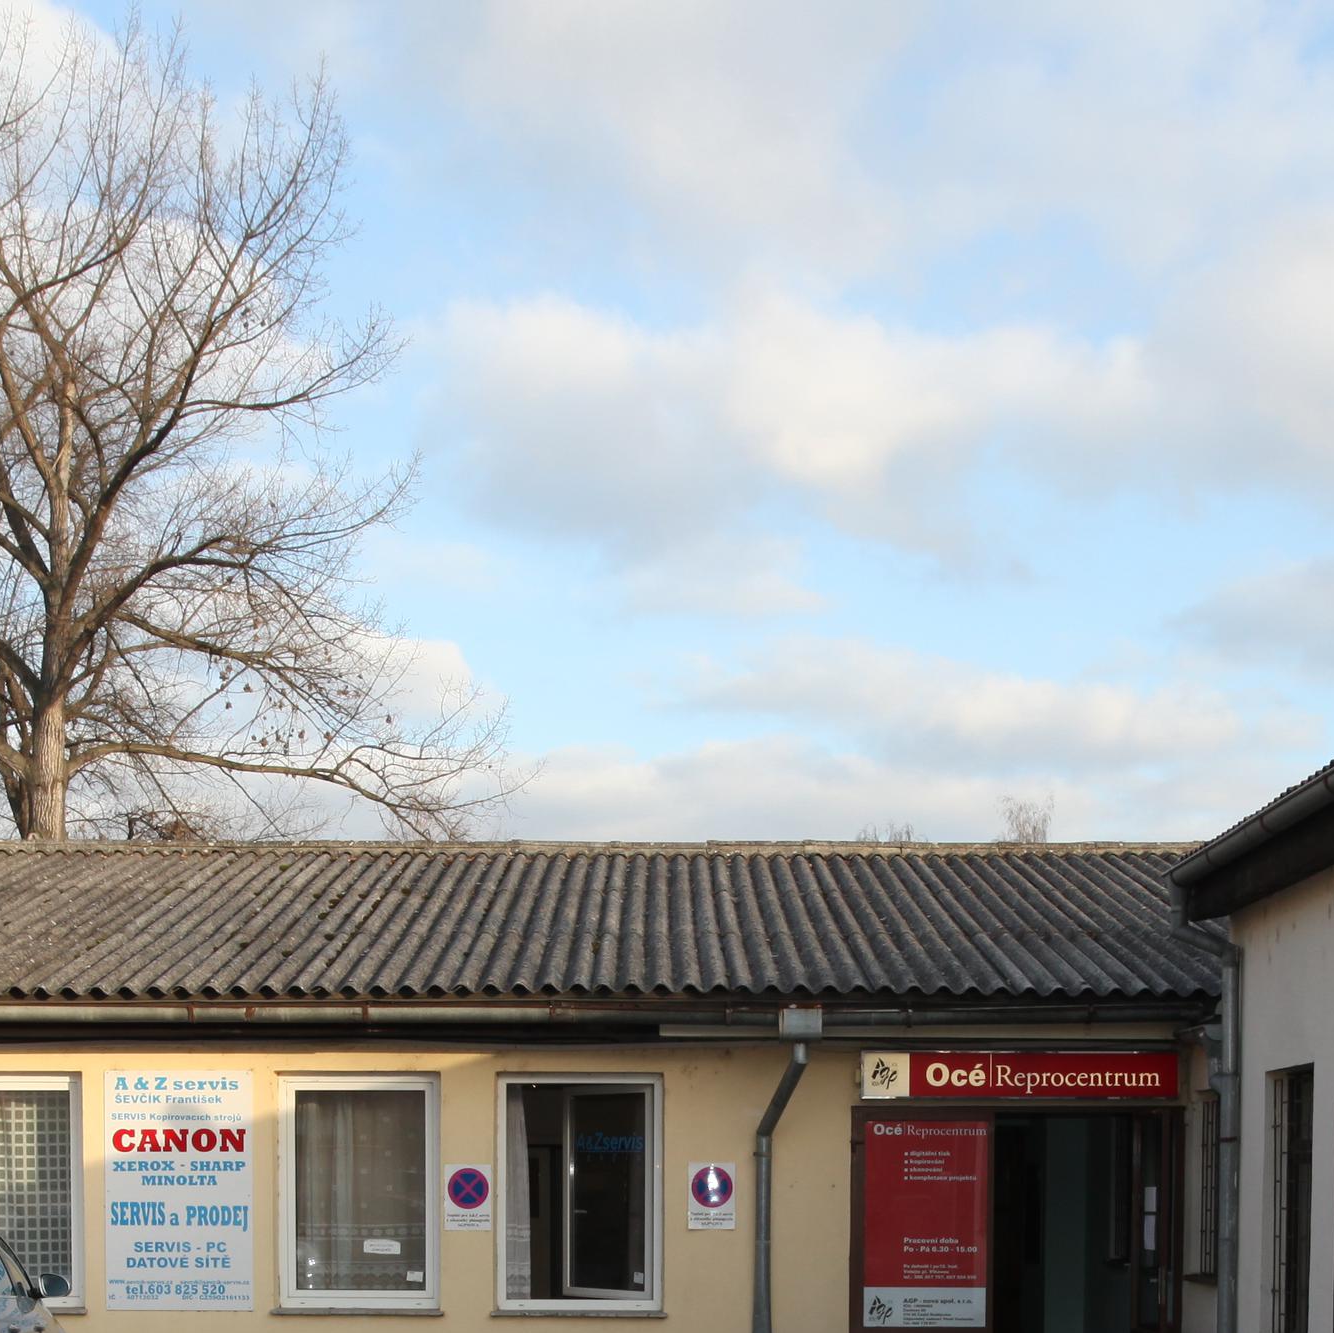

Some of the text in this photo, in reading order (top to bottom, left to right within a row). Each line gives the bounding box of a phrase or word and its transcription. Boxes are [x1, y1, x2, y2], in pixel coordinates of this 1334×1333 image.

[114, 1076, 239, 1091] A & Z servis
[925, 1062, 1161, 1094] Océ Reprocentrum
[114, 1092, 223, 1104] ŠEVČÍK František
[111, 1112, 147, 1121] SERVIS
[873, 1123, 987, 1140] Océ Reprocentrum
[112, 1128, 246, 1153] CANON
[112, 1160, 175, 1172] XEROX
[190, 1160, 246, 1172] SHARP
[141, 1175, 218, 1186] MINOLTA
[110, 1201, 249, 1232] SERVIS a PRODEJ
[903, 1236, 959, 1244] Pracovní doba
[133, 1241, 192, 1253] SERVIS
[206, 1241, 227, 1253] PC
[903, 1245, 914, 1253] Po
[126, 1254, 231, 1269] DATOVÉ SÍTĚ
[175, 1284, 198, 1295] 825
[202, 1284, 226, 1295] 520
